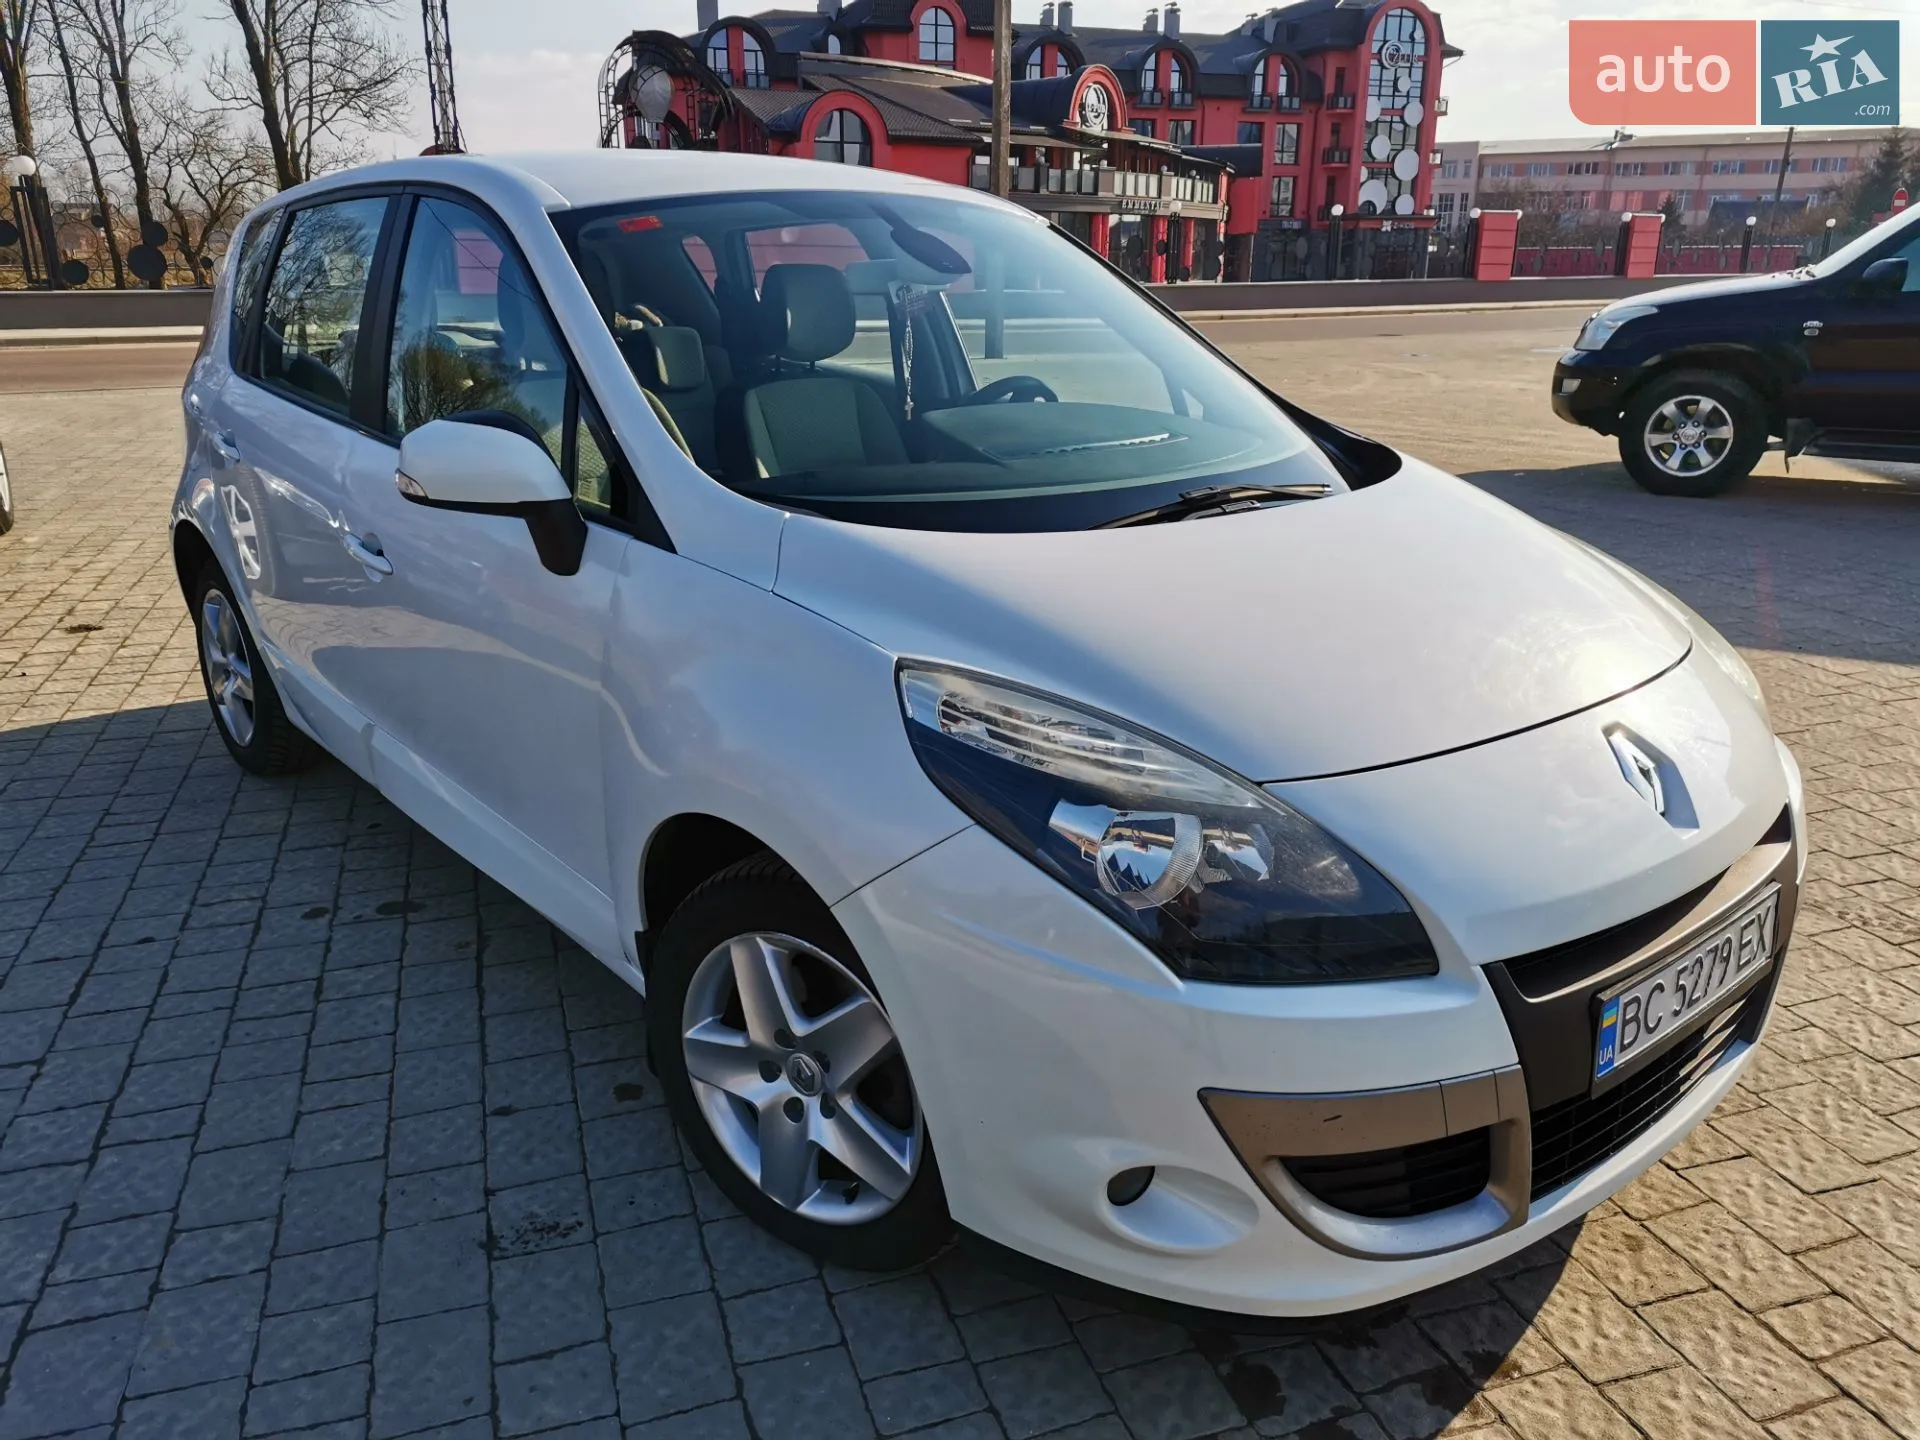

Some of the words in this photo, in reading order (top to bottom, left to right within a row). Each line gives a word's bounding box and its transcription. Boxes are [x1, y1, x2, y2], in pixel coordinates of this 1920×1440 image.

[1621, 980, 1666, 1053] BC
[1673, 935, 1732, 1017] 5279
[1737, 904, 1772, 970] EX
[1599, 1046, 1613, 1065] UA
